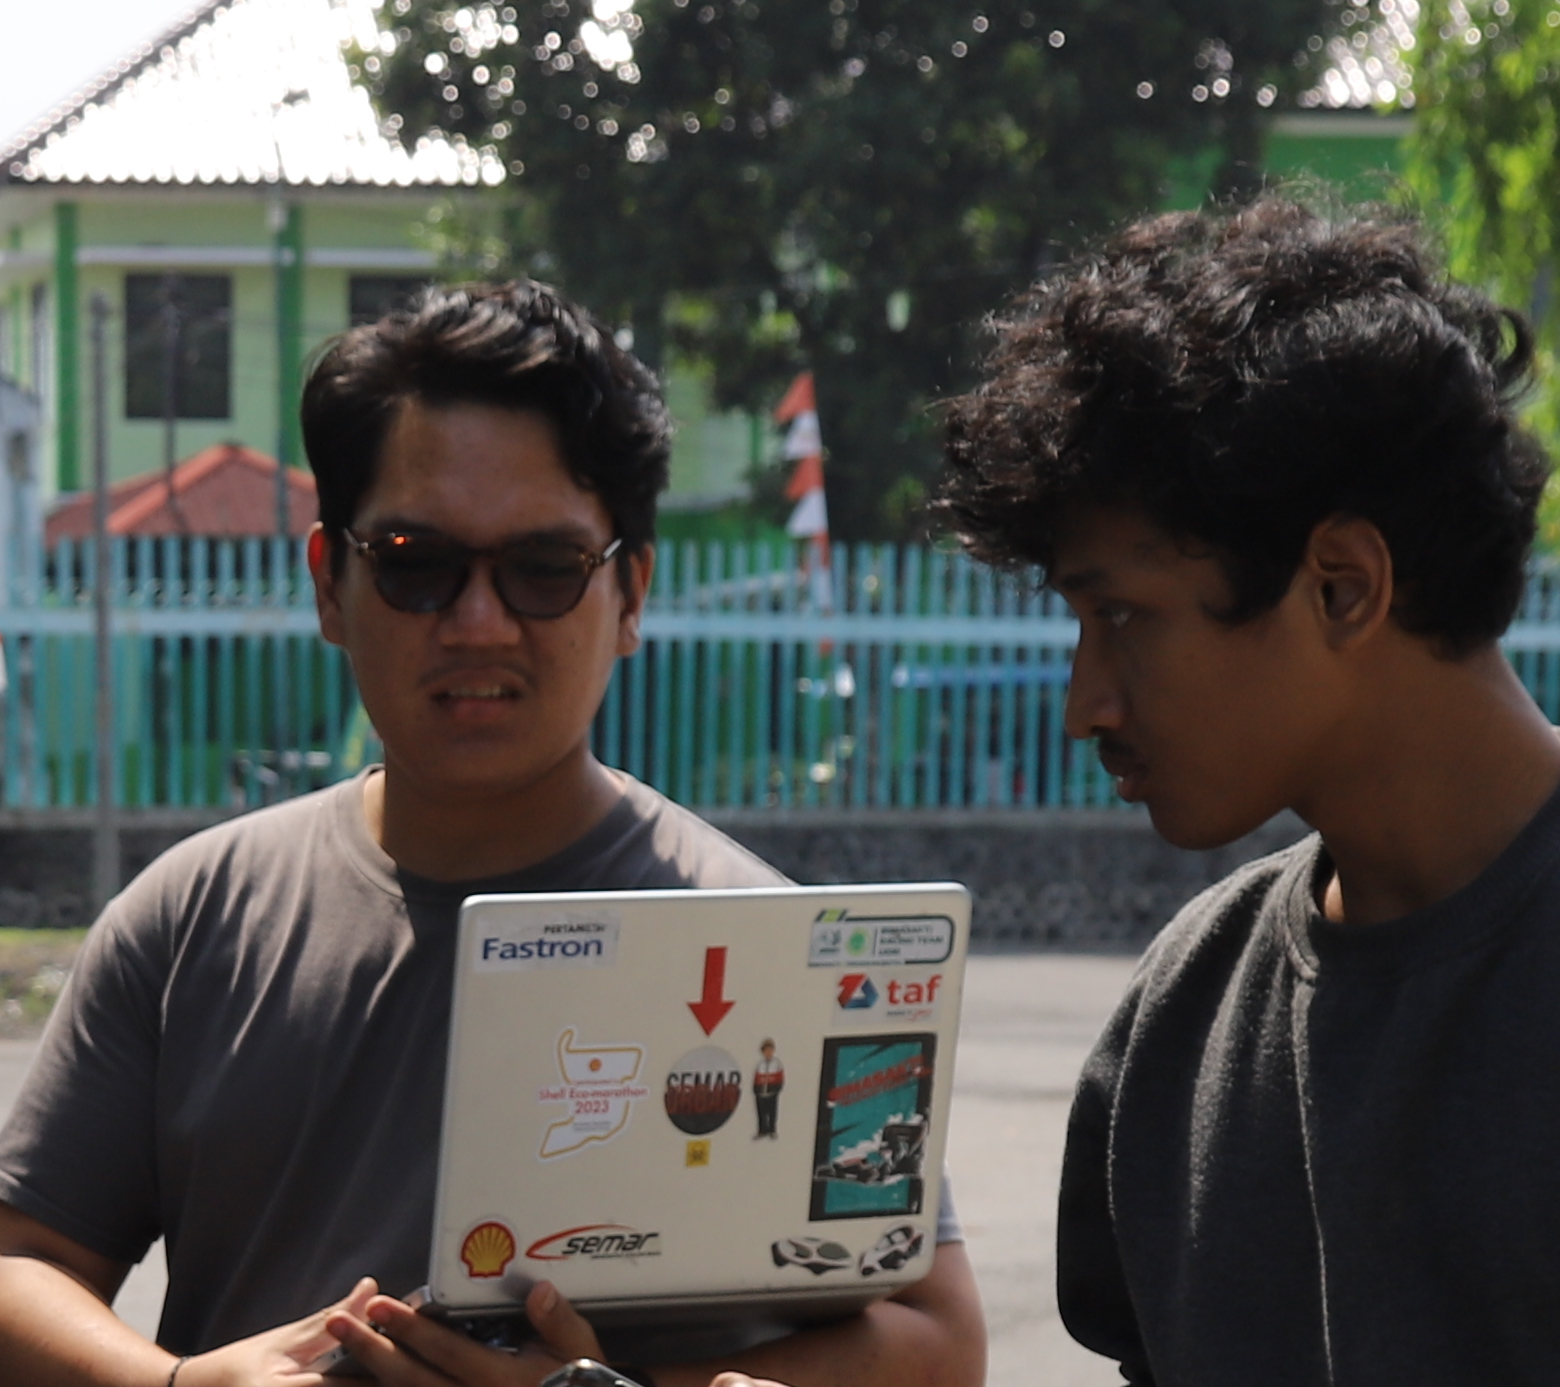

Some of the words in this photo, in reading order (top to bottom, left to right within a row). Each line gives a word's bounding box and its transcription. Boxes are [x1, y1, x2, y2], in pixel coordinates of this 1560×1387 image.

[482, 937, 603, 960] Fastron
[886, 974, 942, 1005] taf
[574, 1101, 610, 1115] 2023
[562, 1232, 660, 1255] semar
